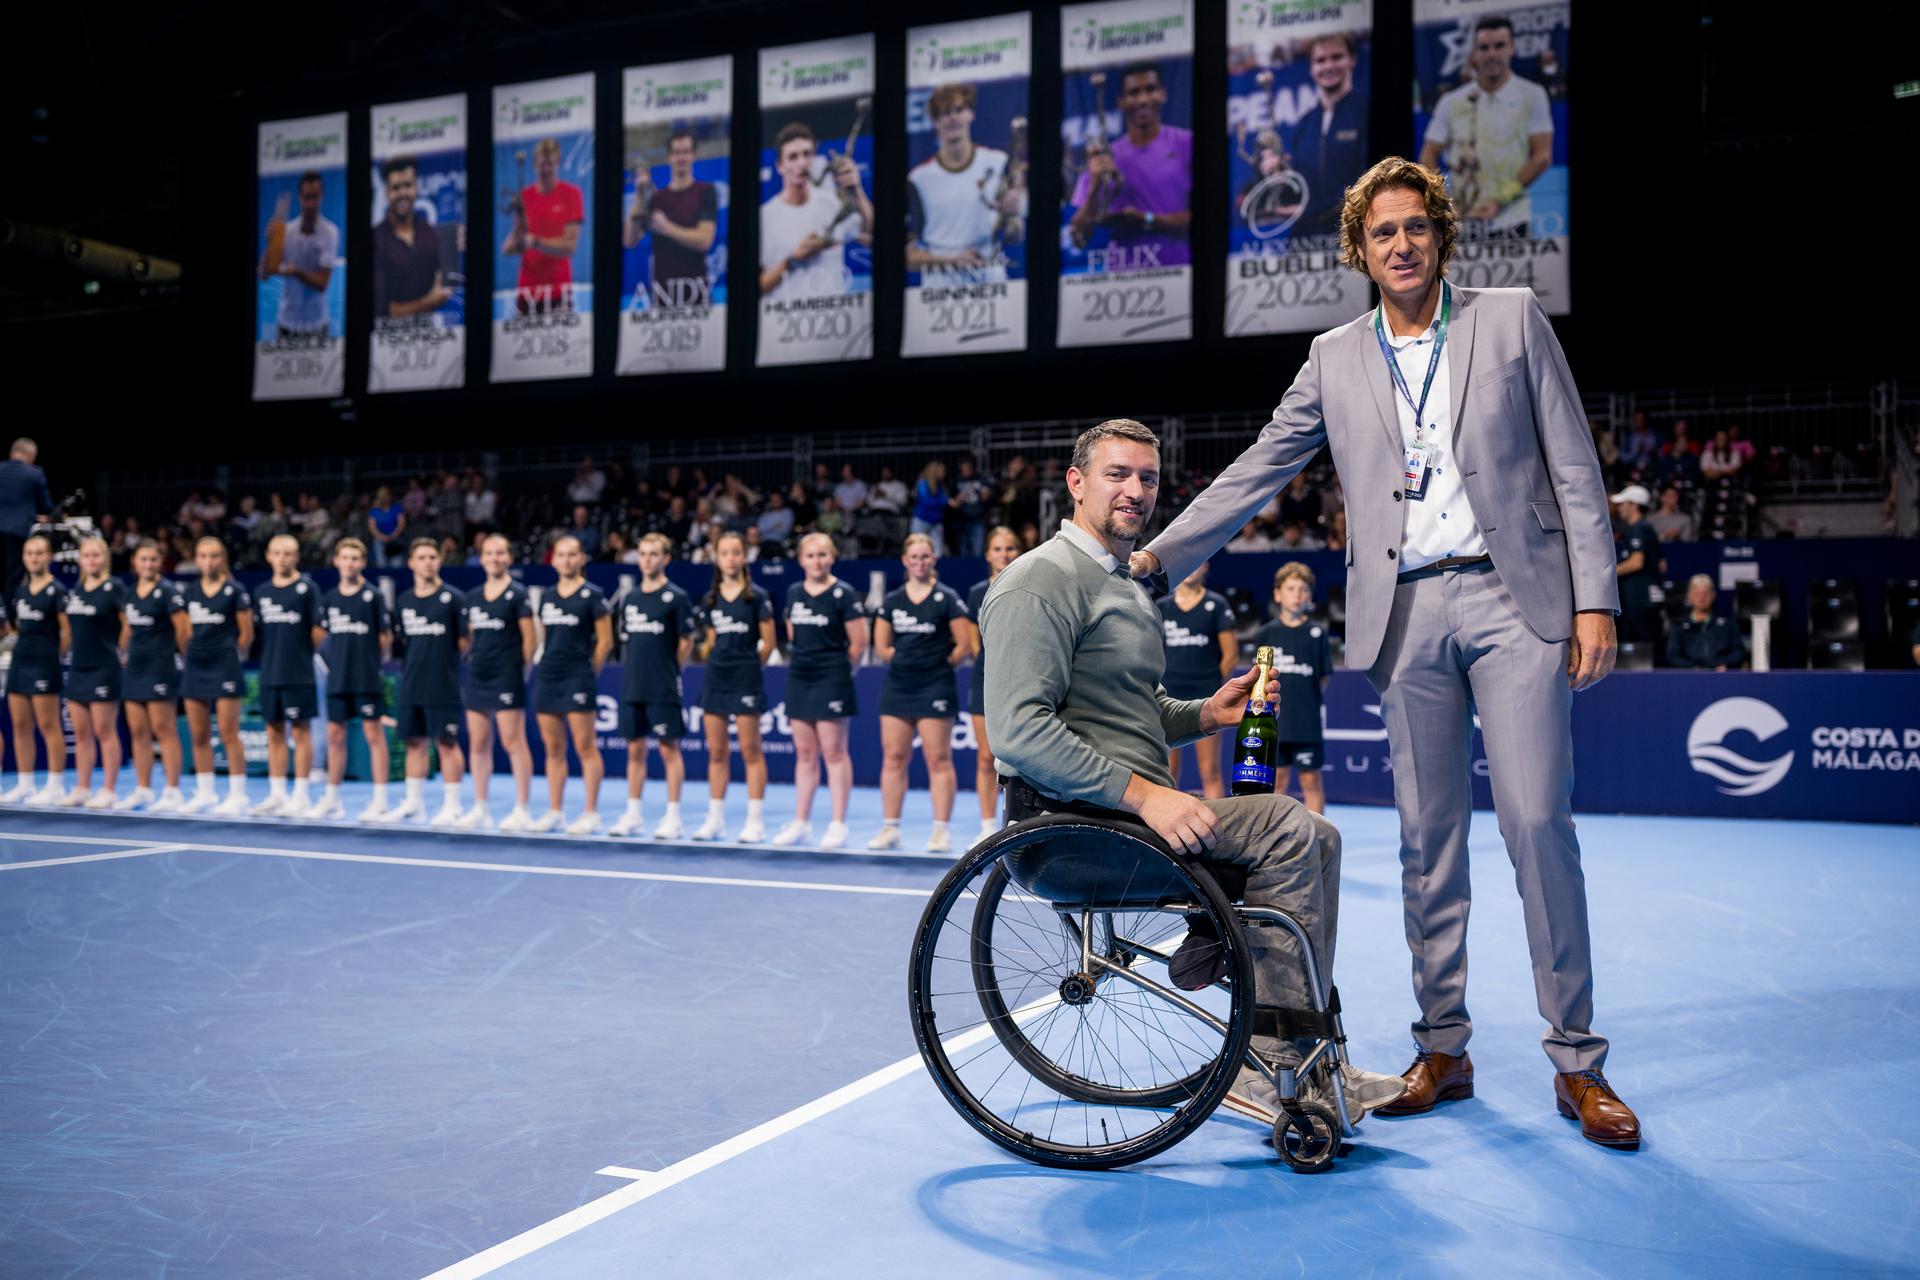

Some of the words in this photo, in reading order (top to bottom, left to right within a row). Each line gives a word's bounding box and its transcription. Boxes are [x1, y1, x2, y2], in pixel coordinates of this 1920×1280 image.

[1088, 241, 1161, 273] FÉLIX
[1240, 234, 1339, 256] ALEXANDE
[1453, 238, 1561, 261] AUTISTA
[1449, 261, 1537, 288] 2024
[629, 277, 712, 311] ANDY
[921, 283, 1007, 304] SINNER
[1083, 286, 1166, 322] 2022
[1255, 273, 1344, 308] 2023
[630, 308, 711, 325] MURRAY
[764, 294, 865, 315] HUMBERT
[929, 301, 996, 333] 2021
[641, 325, 702, 354] 2019
[777, 311, 852, 343] 2020
[390, 346, 440, 373] 2017
[513, 331, 570, 361] 2018
[1811, 726, 1899, 748] COSTA
[1812, 747, 1920, 770] MÁLAGA
